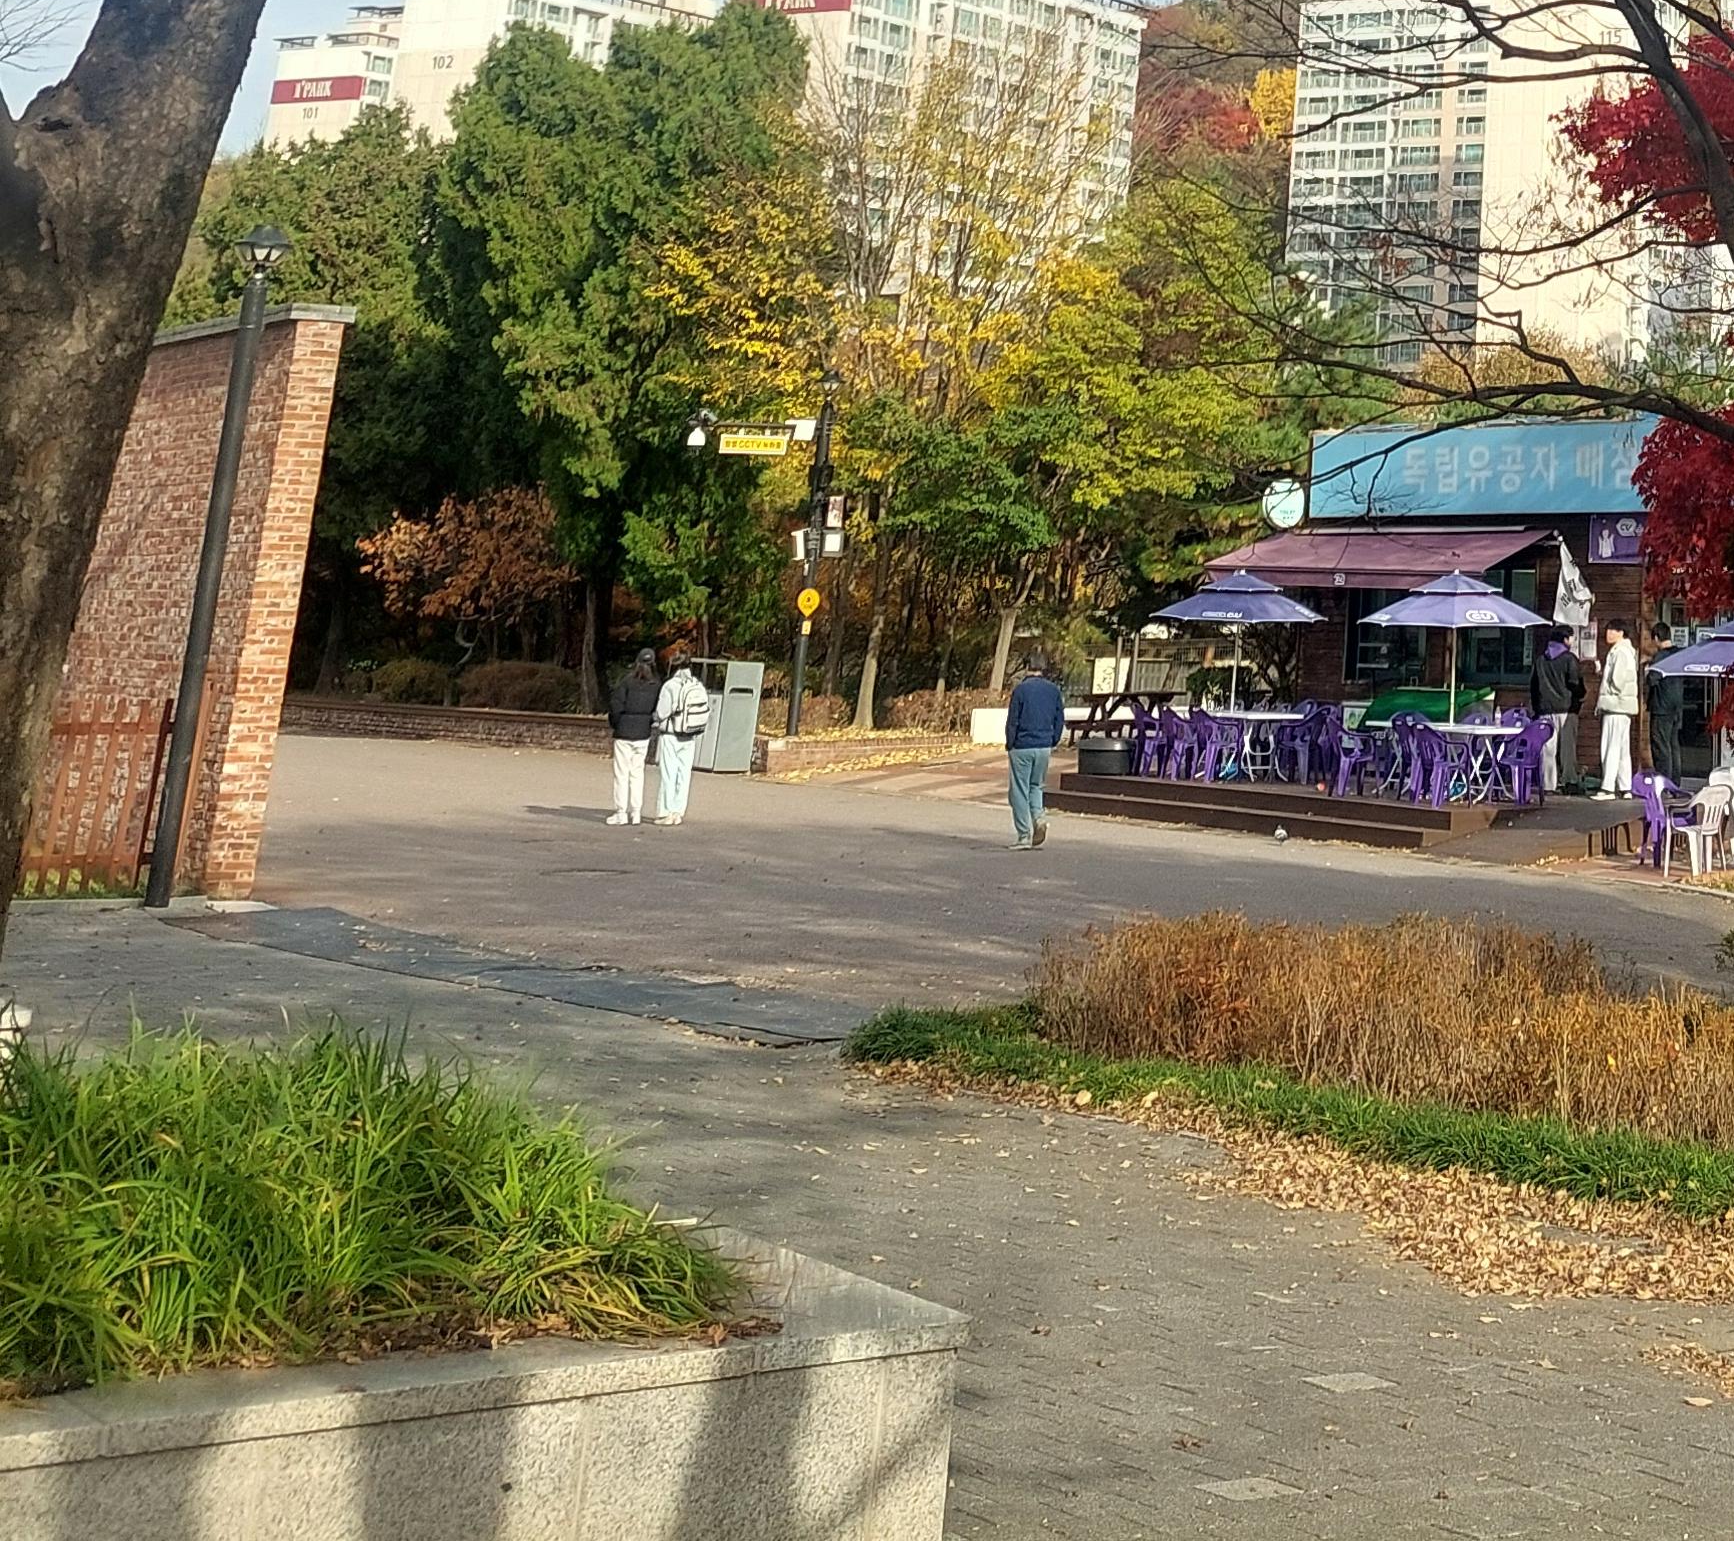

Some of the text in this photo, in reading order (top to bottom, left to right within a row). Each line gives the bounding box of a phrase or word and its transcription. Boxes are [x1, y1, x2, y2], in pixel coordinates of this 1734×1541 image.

[1600, 29, 1621, 45] 115
[432, 55, 454, 69] 102
[303, 107, 318, 119] 101
[1404, 440, 1638, 496] 독립유공자 매점
